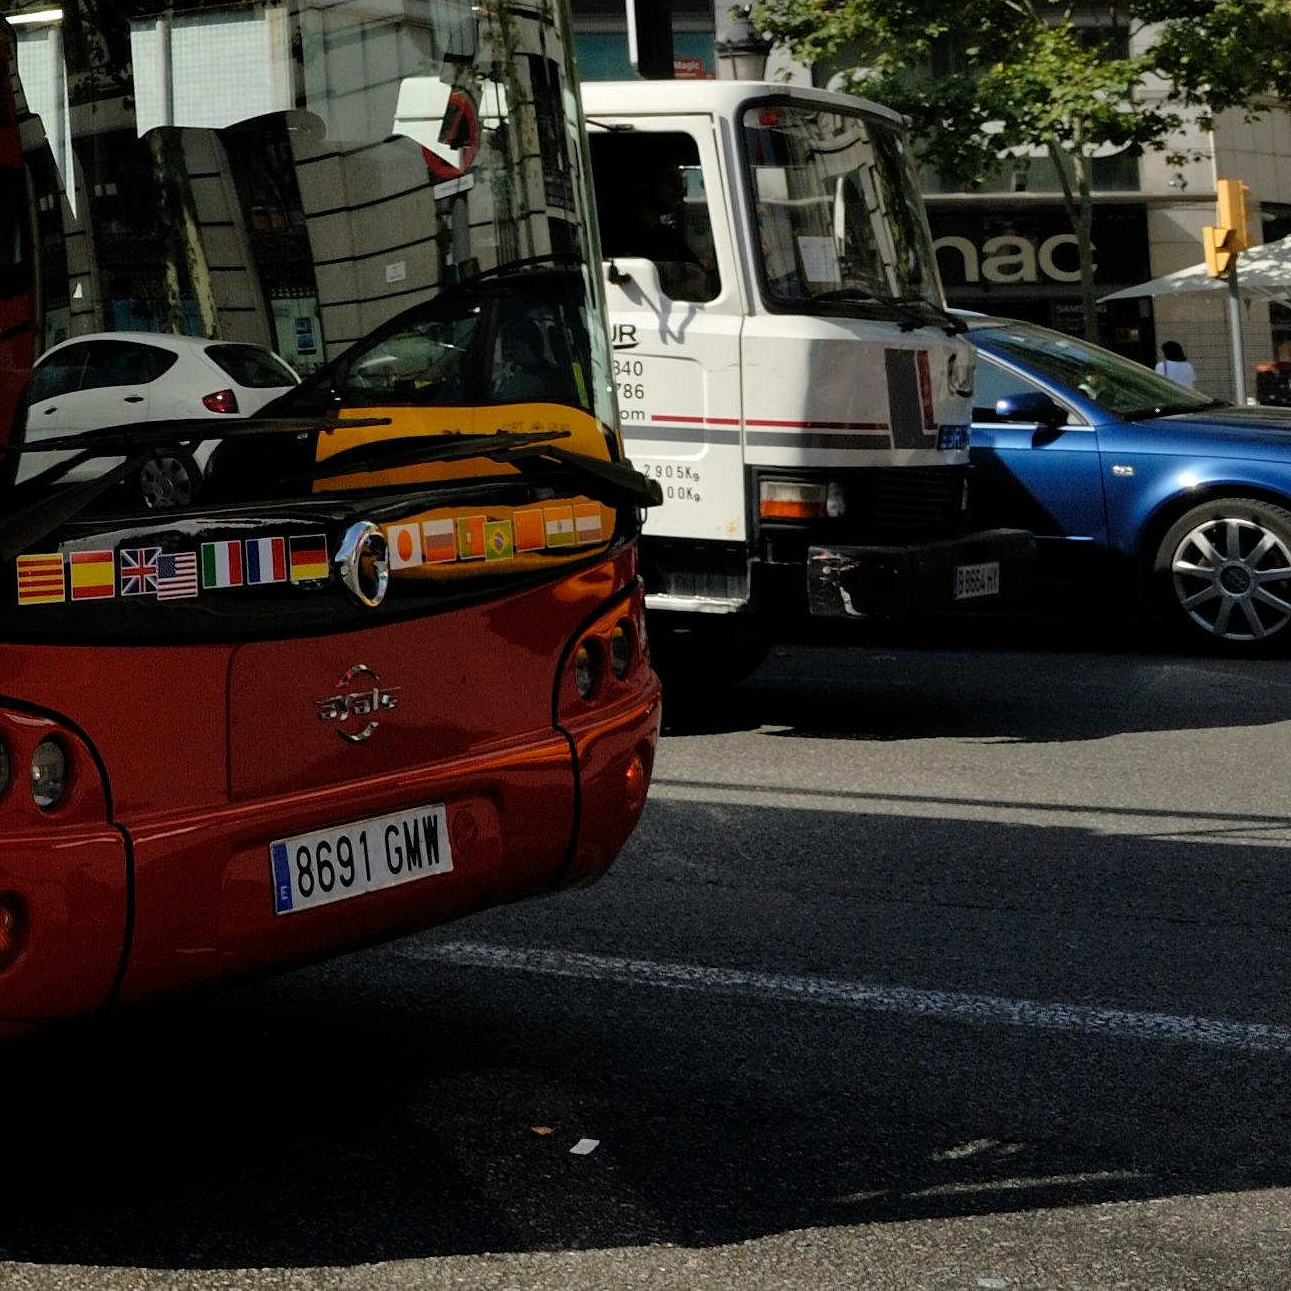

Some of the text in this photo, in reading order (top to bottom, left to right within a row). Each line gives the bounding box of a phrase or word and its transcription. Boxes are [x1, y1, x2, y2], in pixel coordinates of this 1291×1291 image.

[296, 814, 440, 898] 8691 GMW
[280, 885, 289, 901] E
